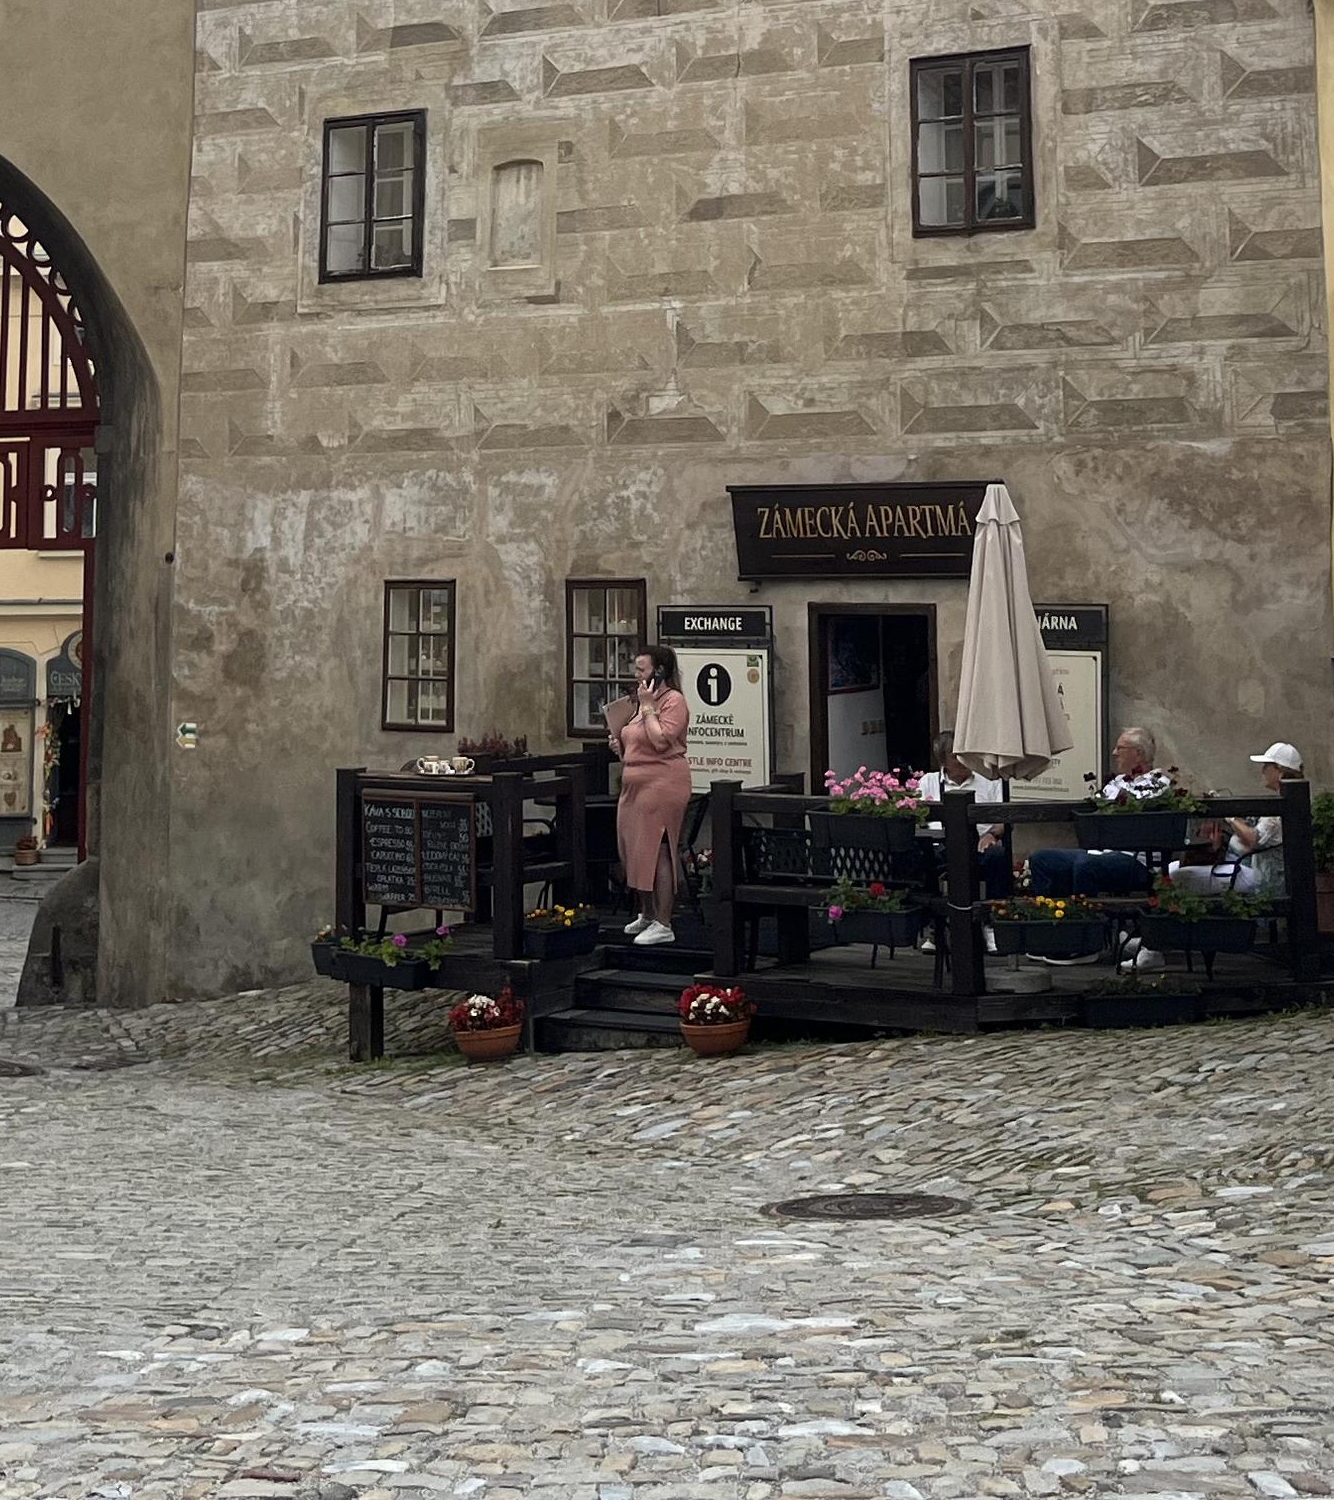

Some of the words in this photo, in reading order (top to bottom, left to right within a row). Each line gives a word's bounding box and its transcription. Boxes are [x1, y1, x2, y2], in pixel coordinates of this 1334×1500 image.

[757, 502, 861, 539] ZÁMECKÁ
[865, 501, 971, 539] APARTMÁ
[684, 616, 742, 631] EXCHANGE
[1038, 613, 1078, 631] ÁRNA
[688, 727, 745, 738] NFOCENTRUM
[688, 756, 703, 766] STLE
